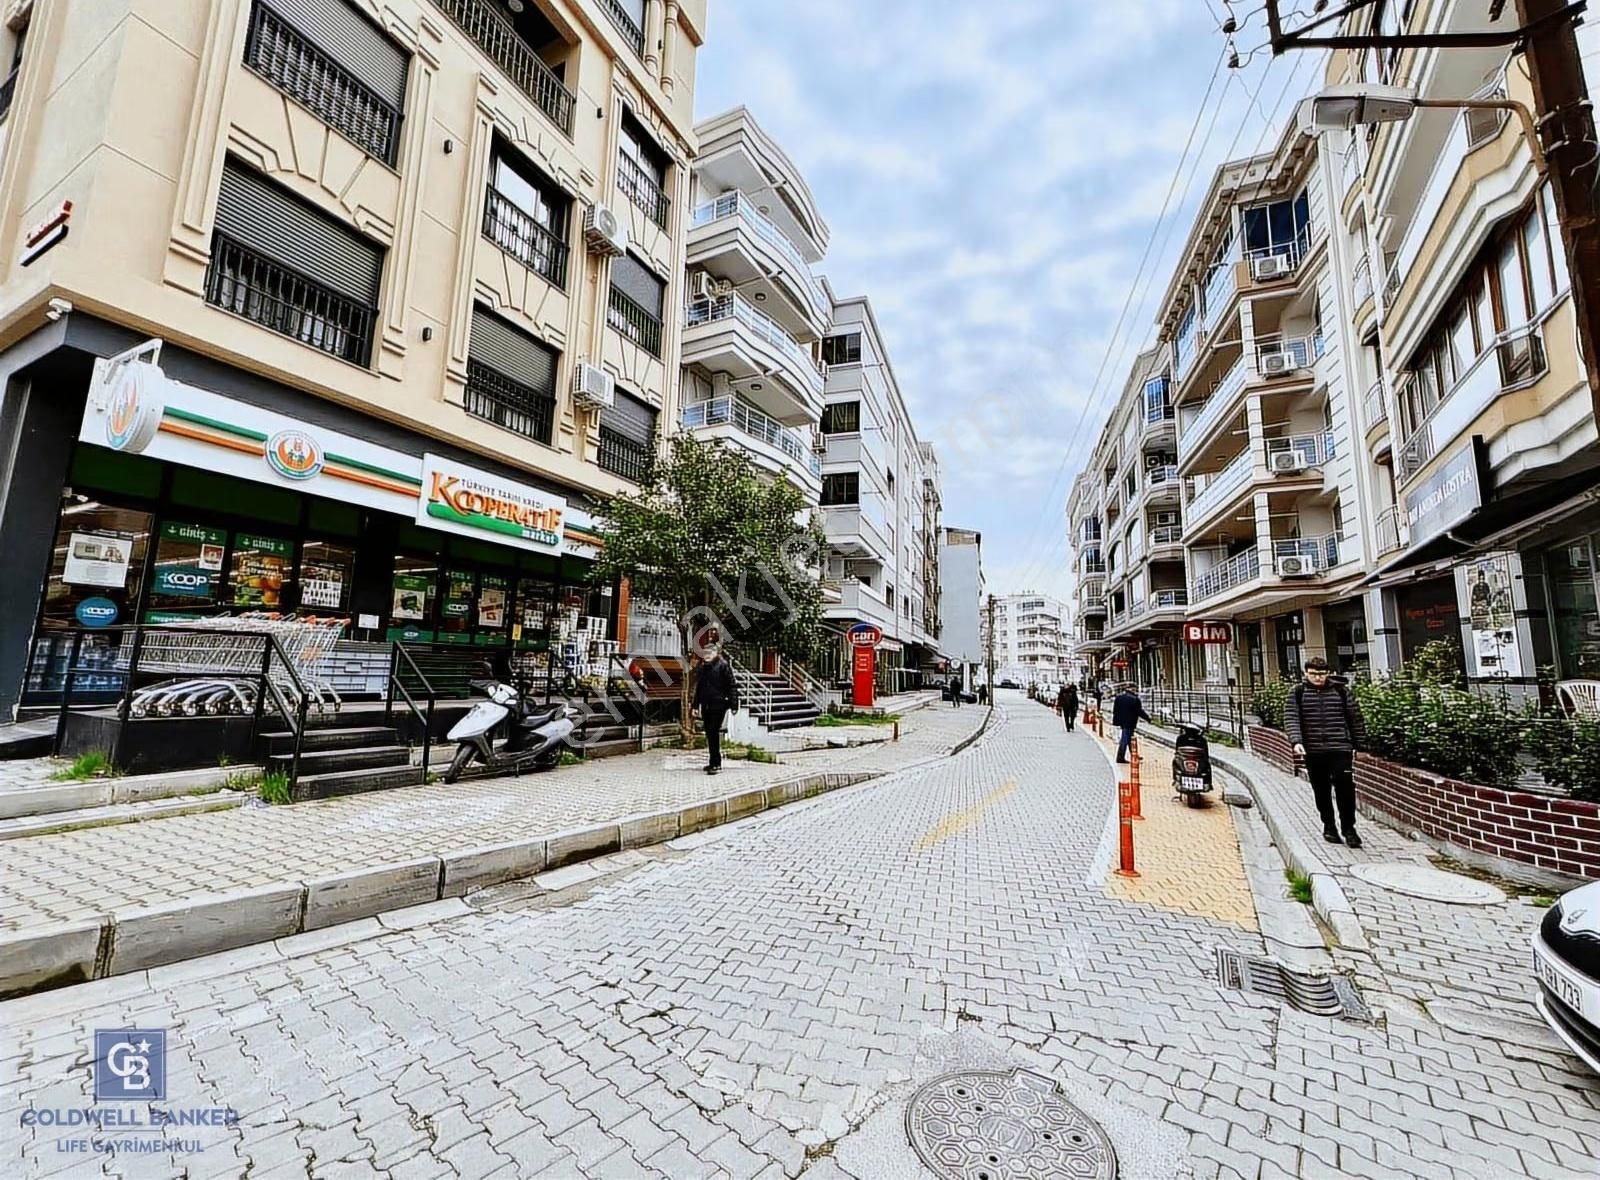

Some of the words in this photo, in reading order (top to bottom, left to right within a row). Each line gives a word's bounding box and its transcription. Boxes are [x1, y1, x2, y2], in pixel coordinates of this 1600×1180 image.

[498, 489, 520, 502] TARIM
[522, 528, 555, 545] market
[1189, 624, 1227, 641] BİM
